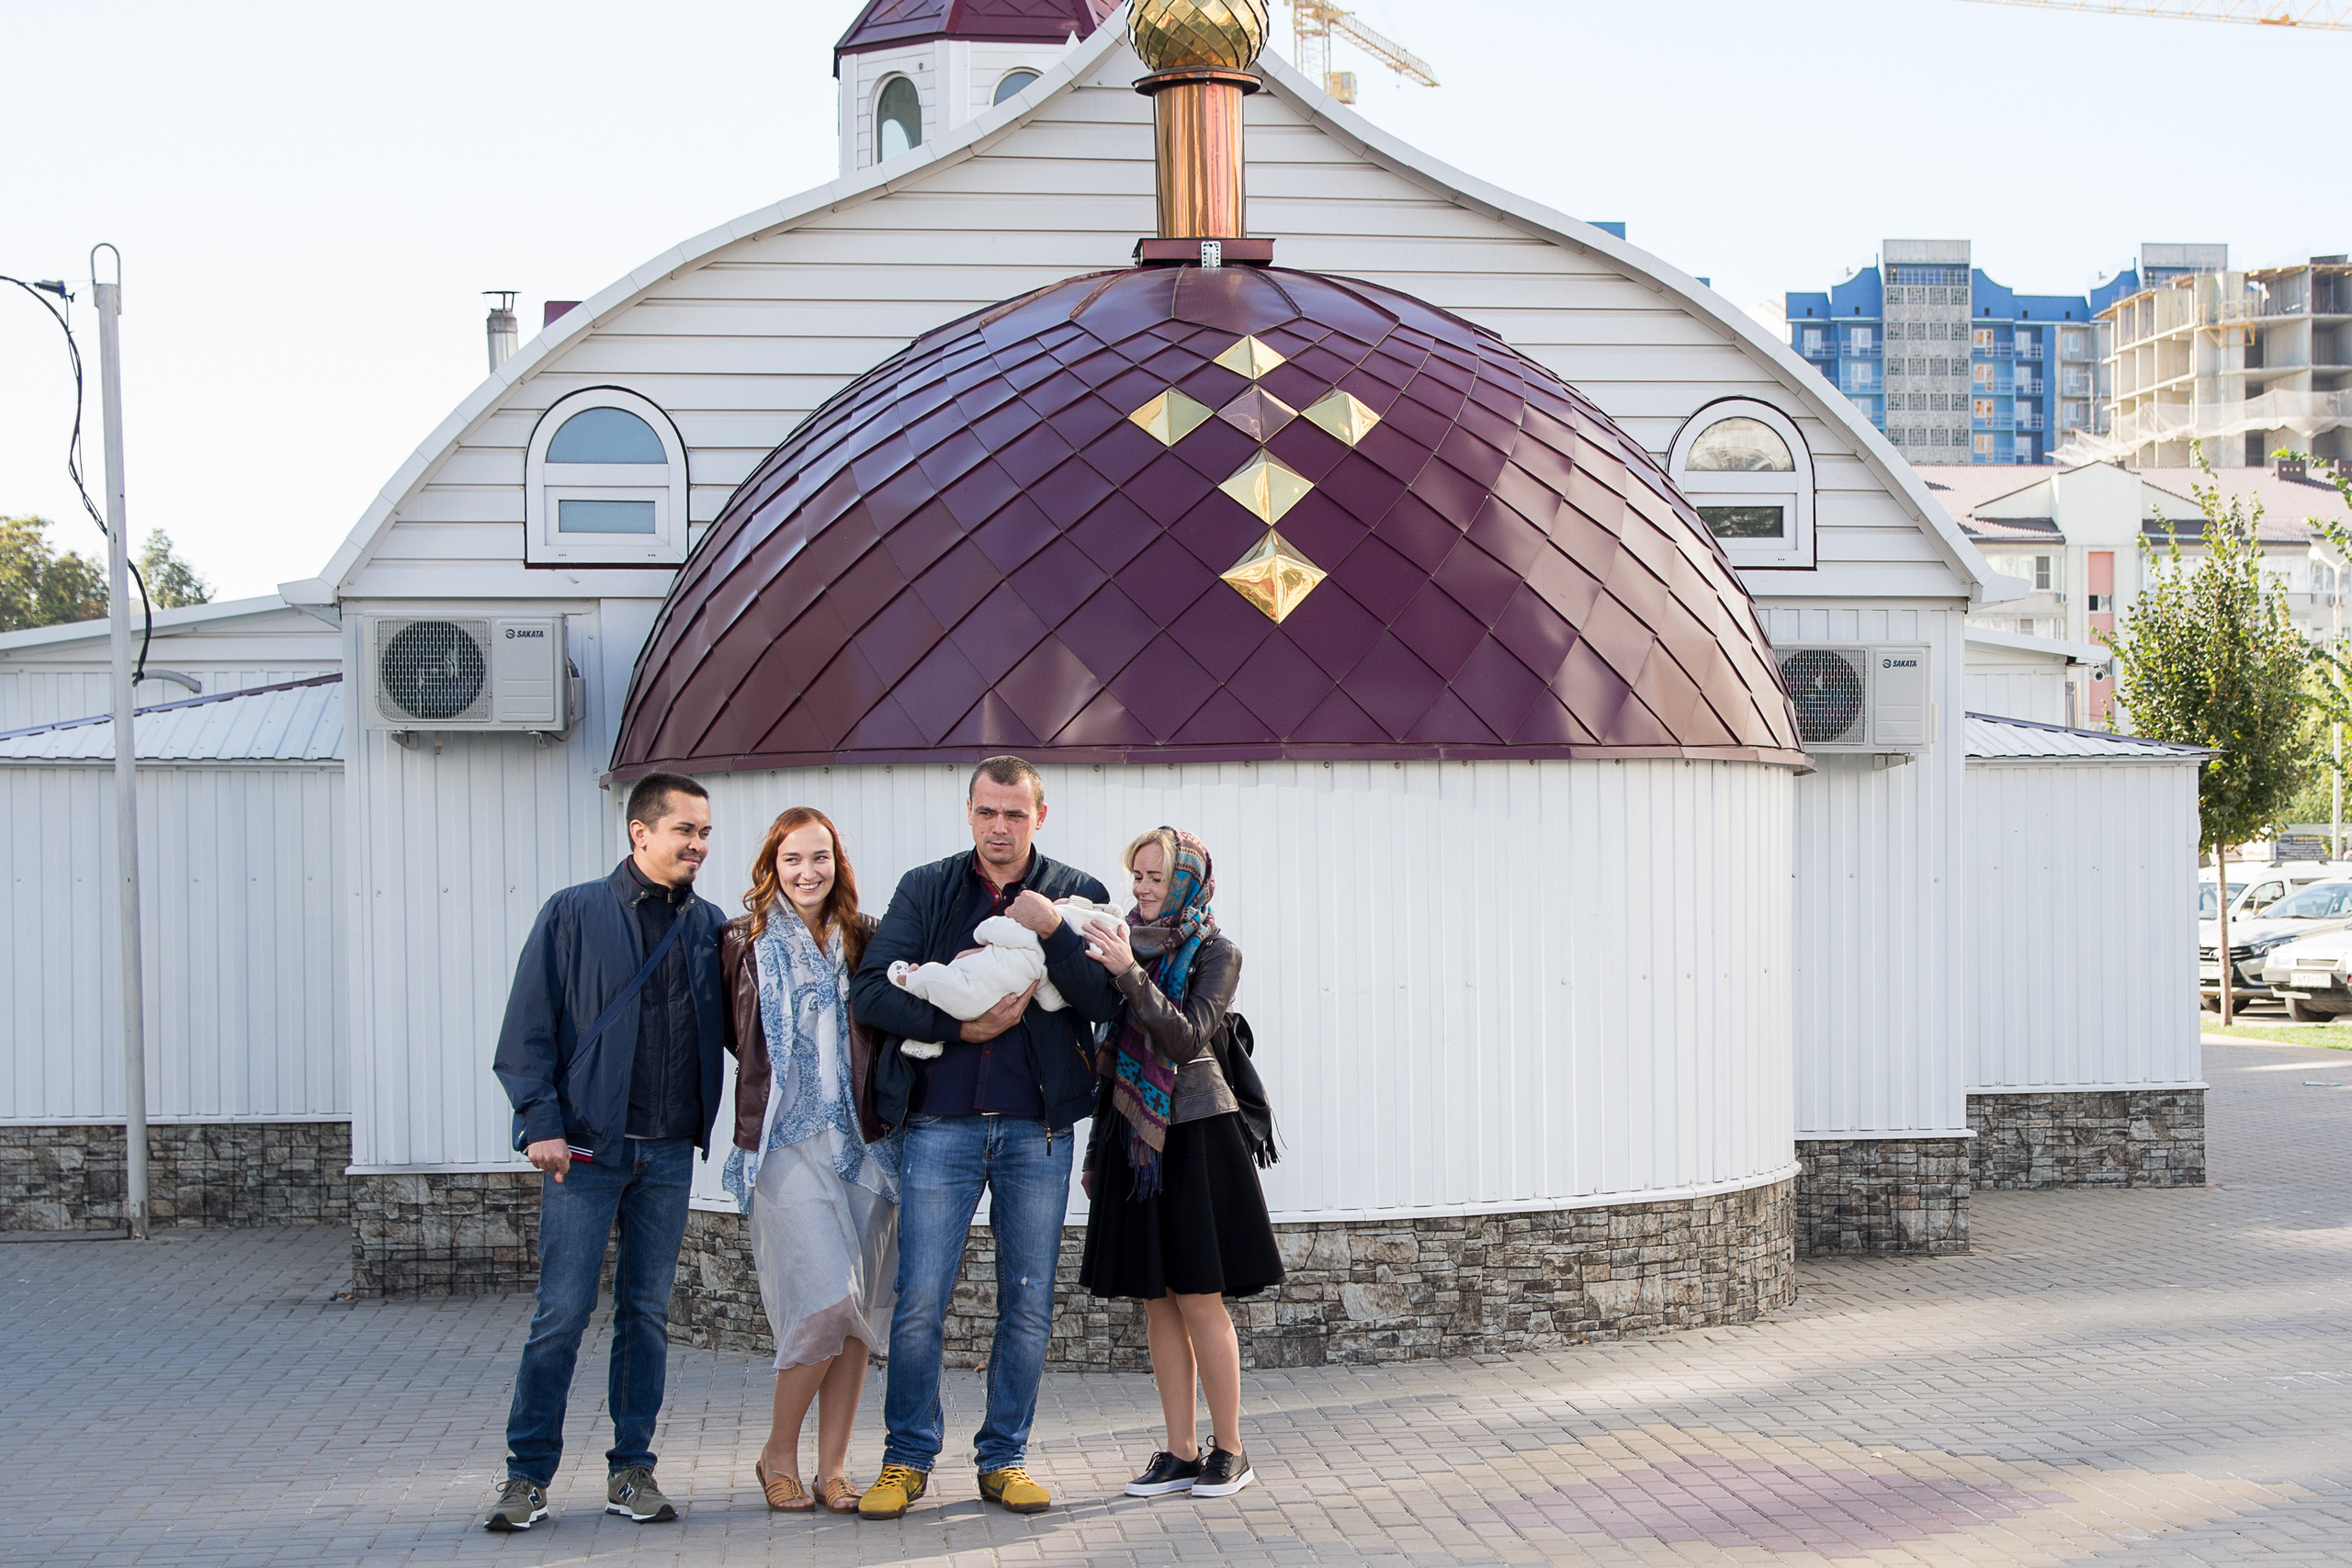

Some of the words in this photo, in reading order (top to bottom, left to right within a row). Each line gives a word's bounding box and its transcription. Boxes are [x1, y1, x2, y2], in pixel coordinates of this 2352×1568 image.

[516, 629, 544, 638] SAKATA
[1893, 660, 1917, 668] SAKATA
[616, 1482, 635, 1505] N
